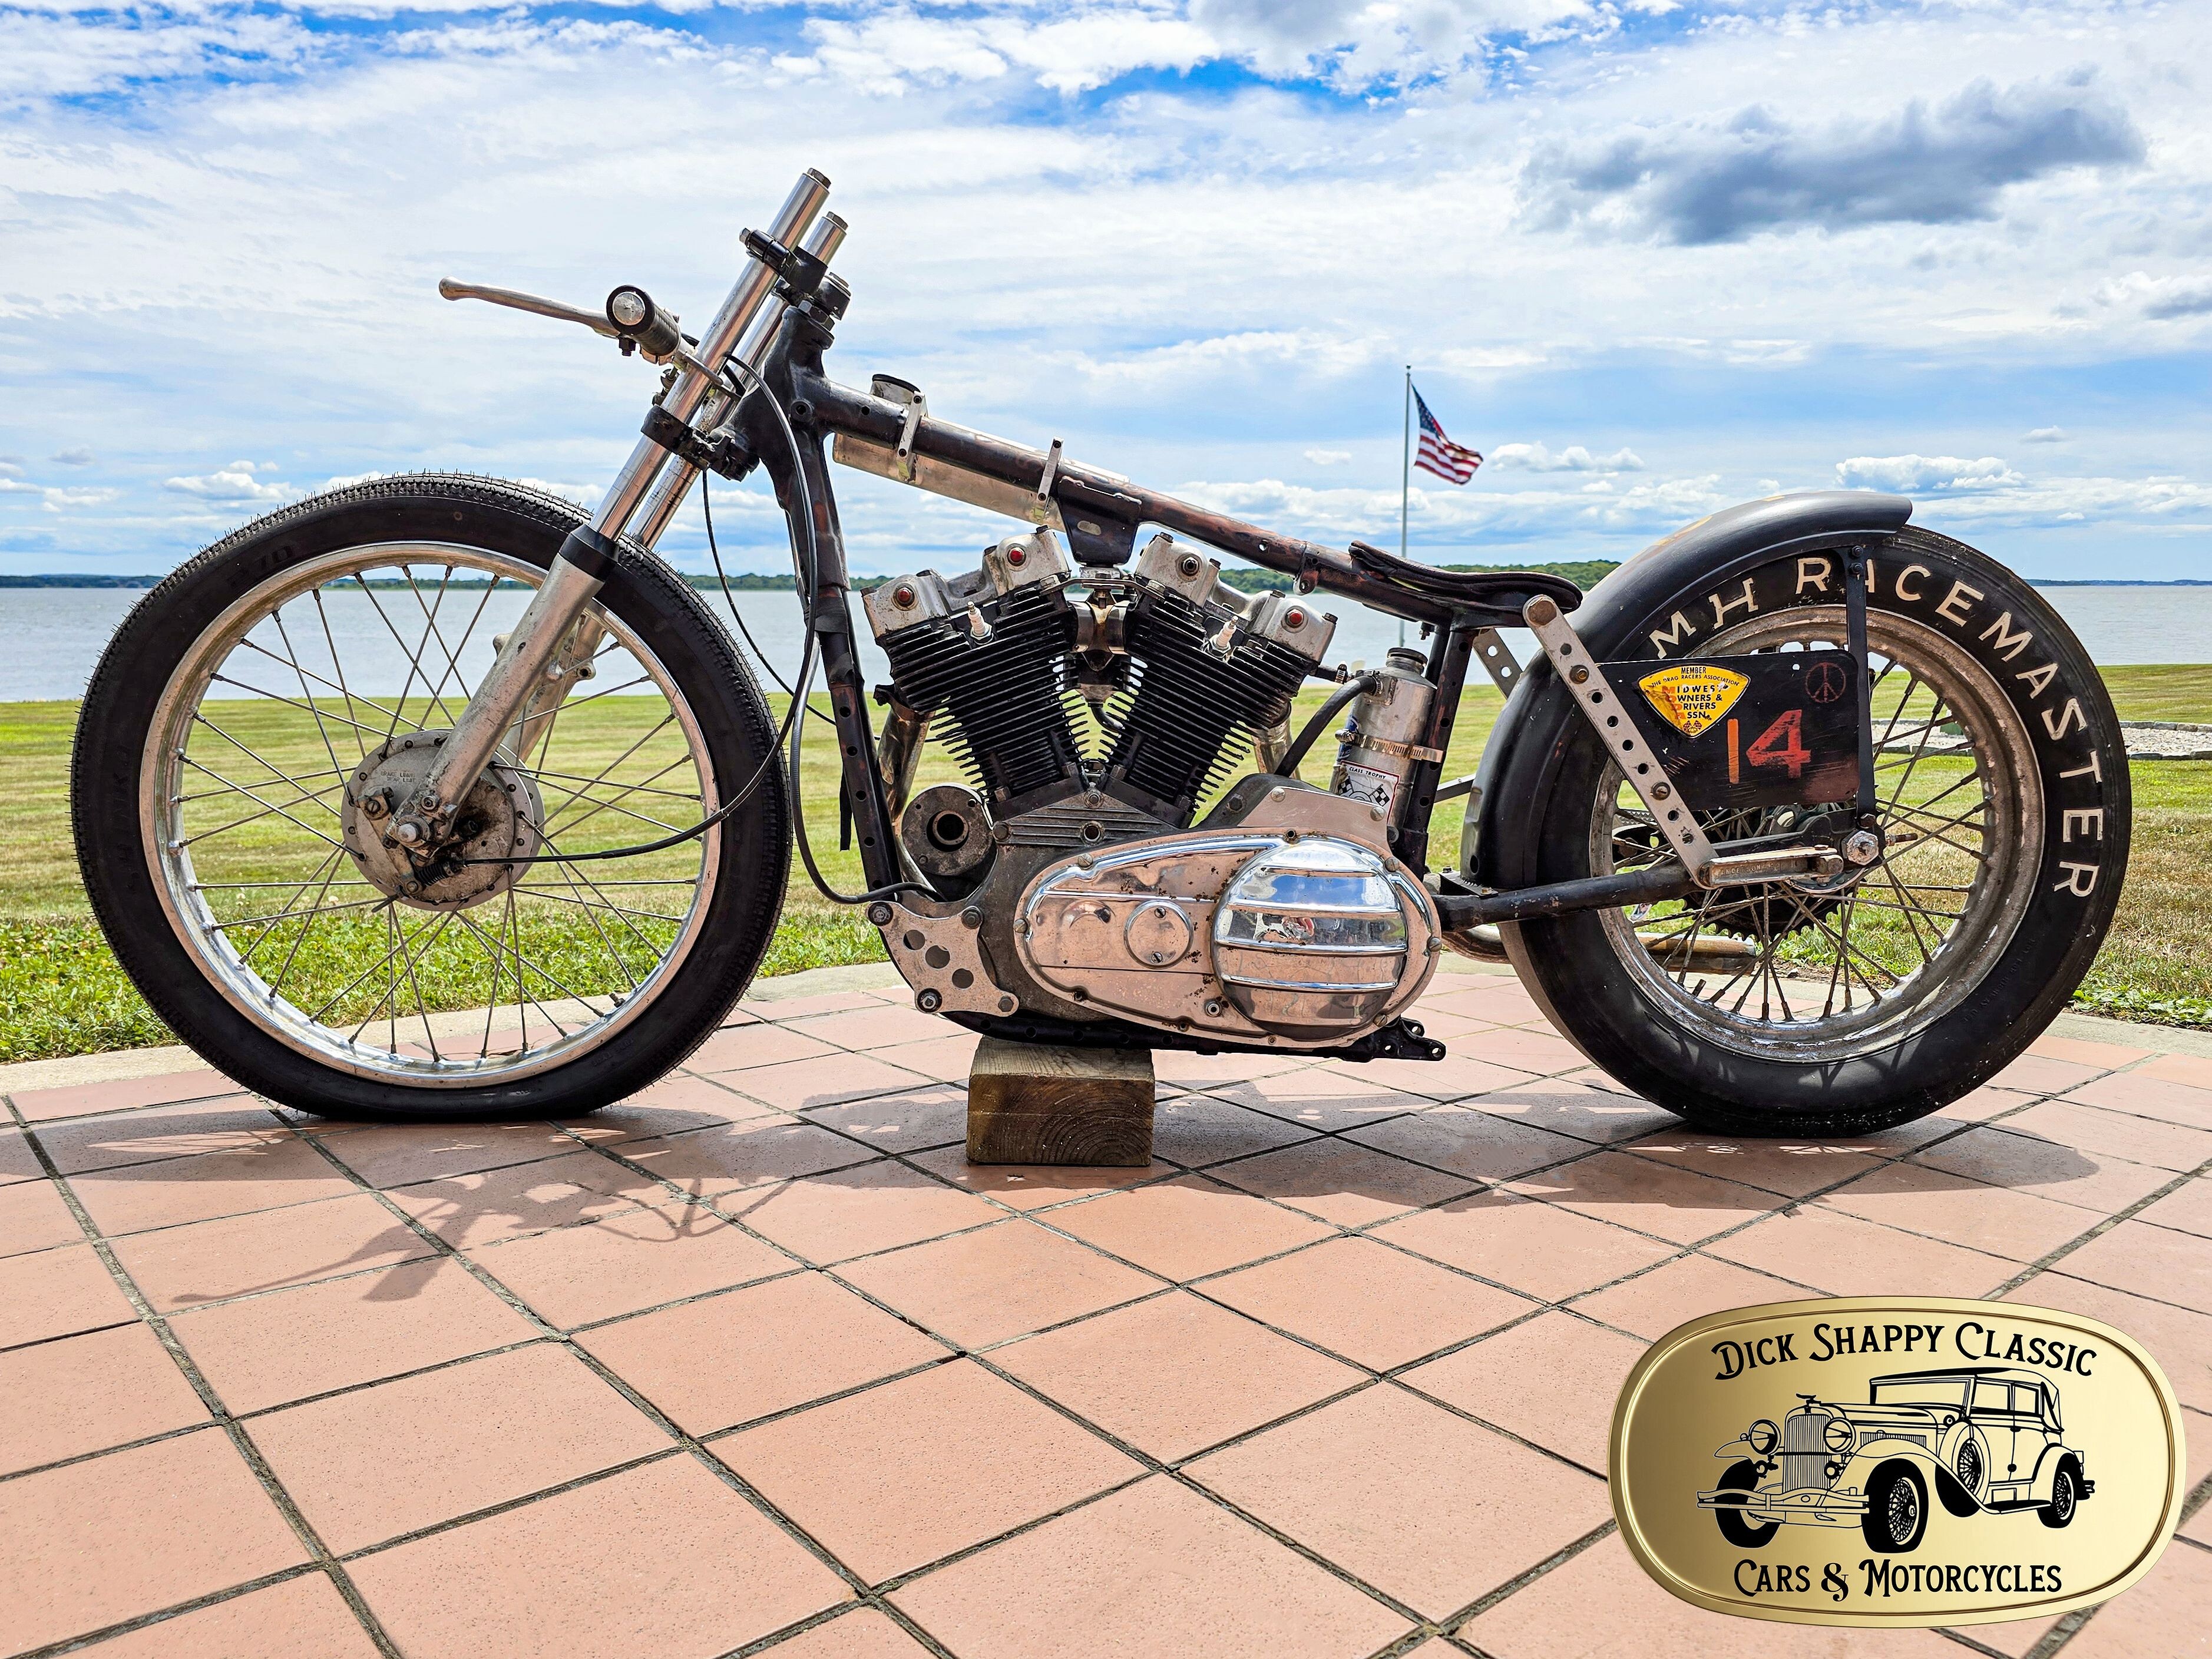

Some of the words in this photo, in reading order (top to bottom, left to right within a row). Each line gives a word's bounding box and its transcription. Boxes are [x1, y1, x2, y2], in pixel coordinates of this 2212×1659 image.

[1649, 577, 1758, 659] MH
[1704, 674, 1740, 686] ASSOCIATION
[1727, 709, 1811, 784] 14
[1365, 771, 1386, 779] TROPHY
